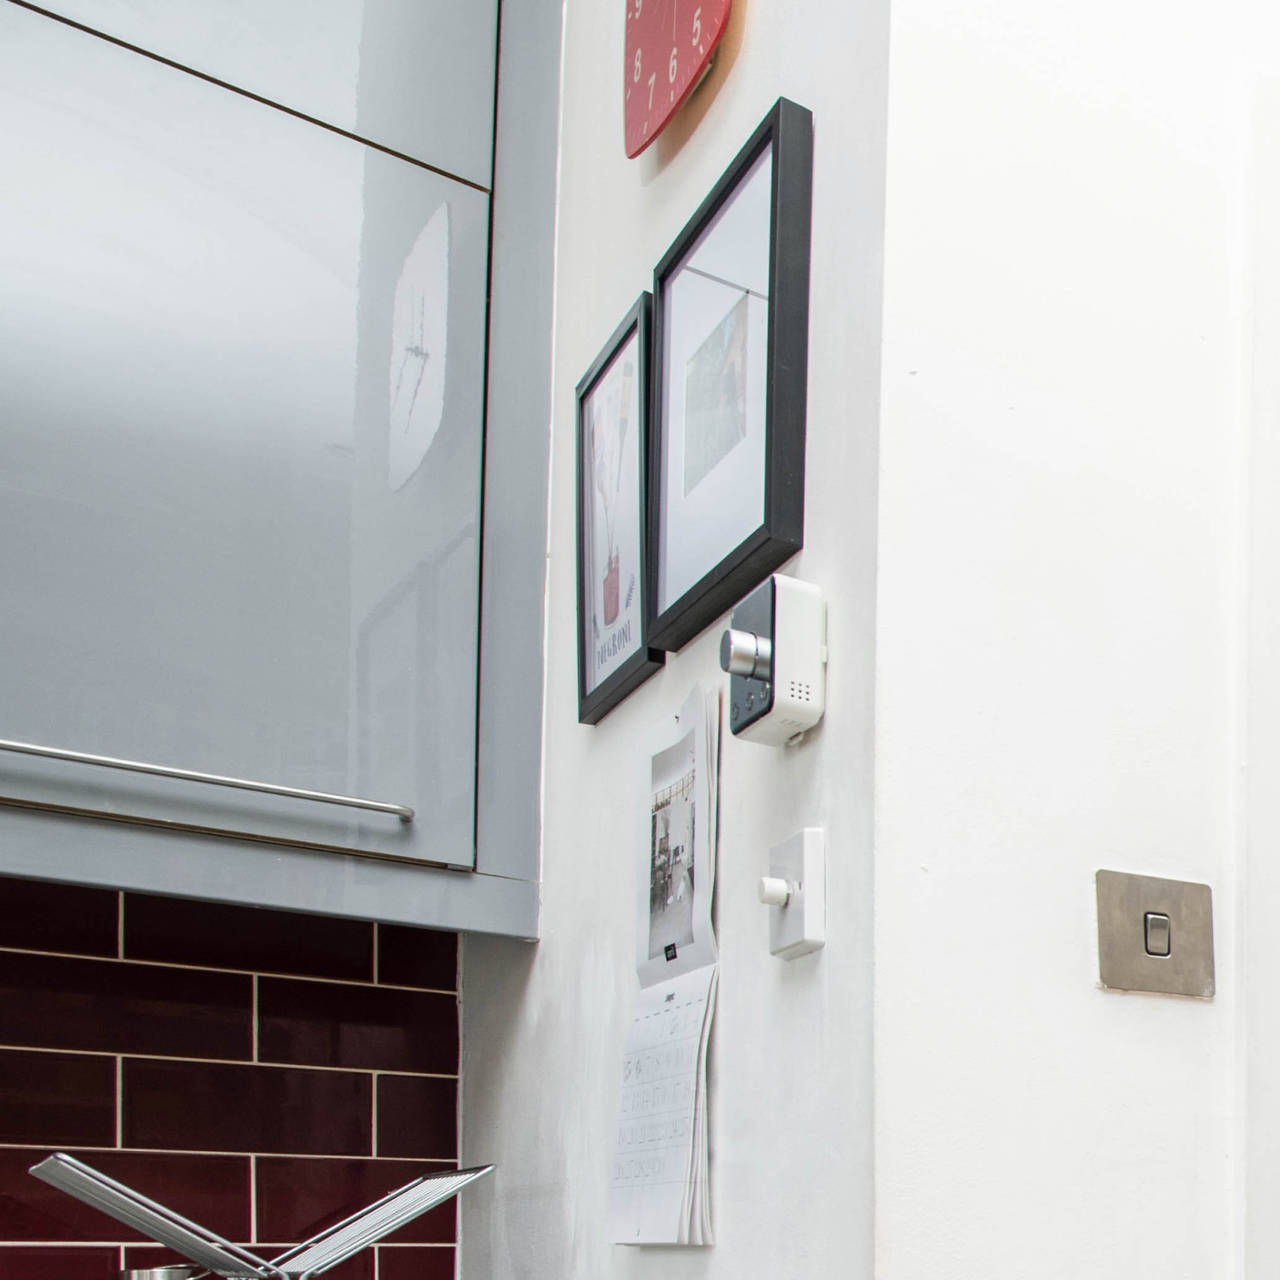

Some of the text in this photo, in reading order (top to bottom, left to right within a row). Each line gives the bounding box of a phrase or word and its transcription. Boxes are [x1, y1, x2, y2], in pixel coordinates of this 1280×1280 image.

[692, 6, 702, 46] 5
[634, 47, 642, 83] 8
[669, 47, 677, 84] 6
[648, 72, 656, 111] 7
[597, 619, 631, 669] NEGRONI
